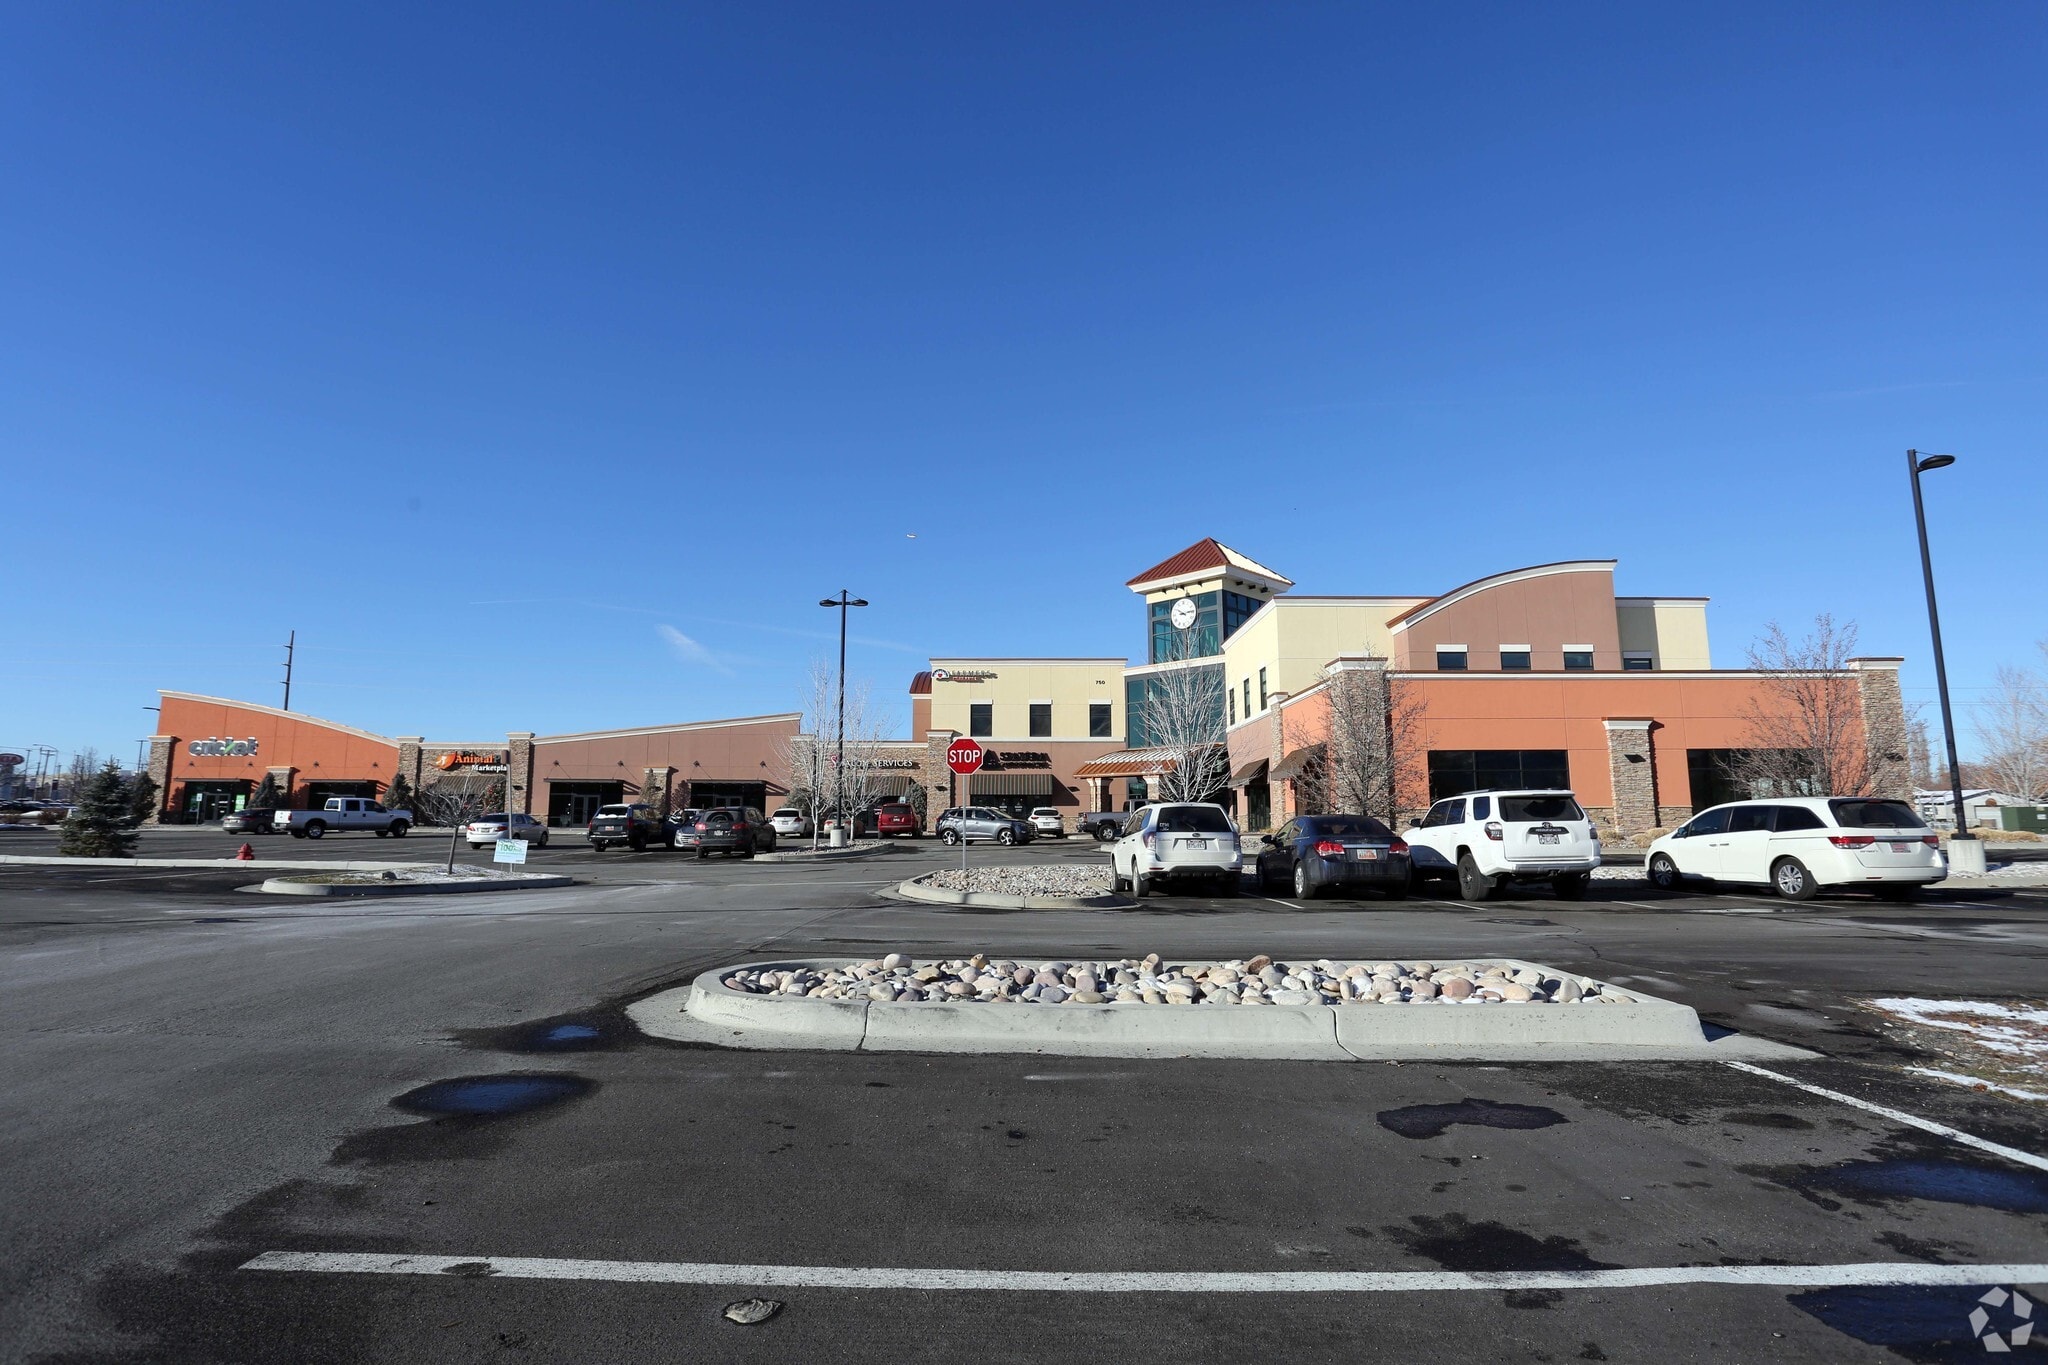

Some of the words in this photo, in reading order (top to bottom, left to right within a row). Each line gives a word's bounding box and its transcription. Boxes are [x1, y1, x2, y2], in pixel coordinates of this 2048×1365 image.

[189, 736, 258, 757] cricket
[455, 754, 494, 763] Animal
[949, 749, 981, 763] STOP
[871, 759, 913, 767] SERVICES
